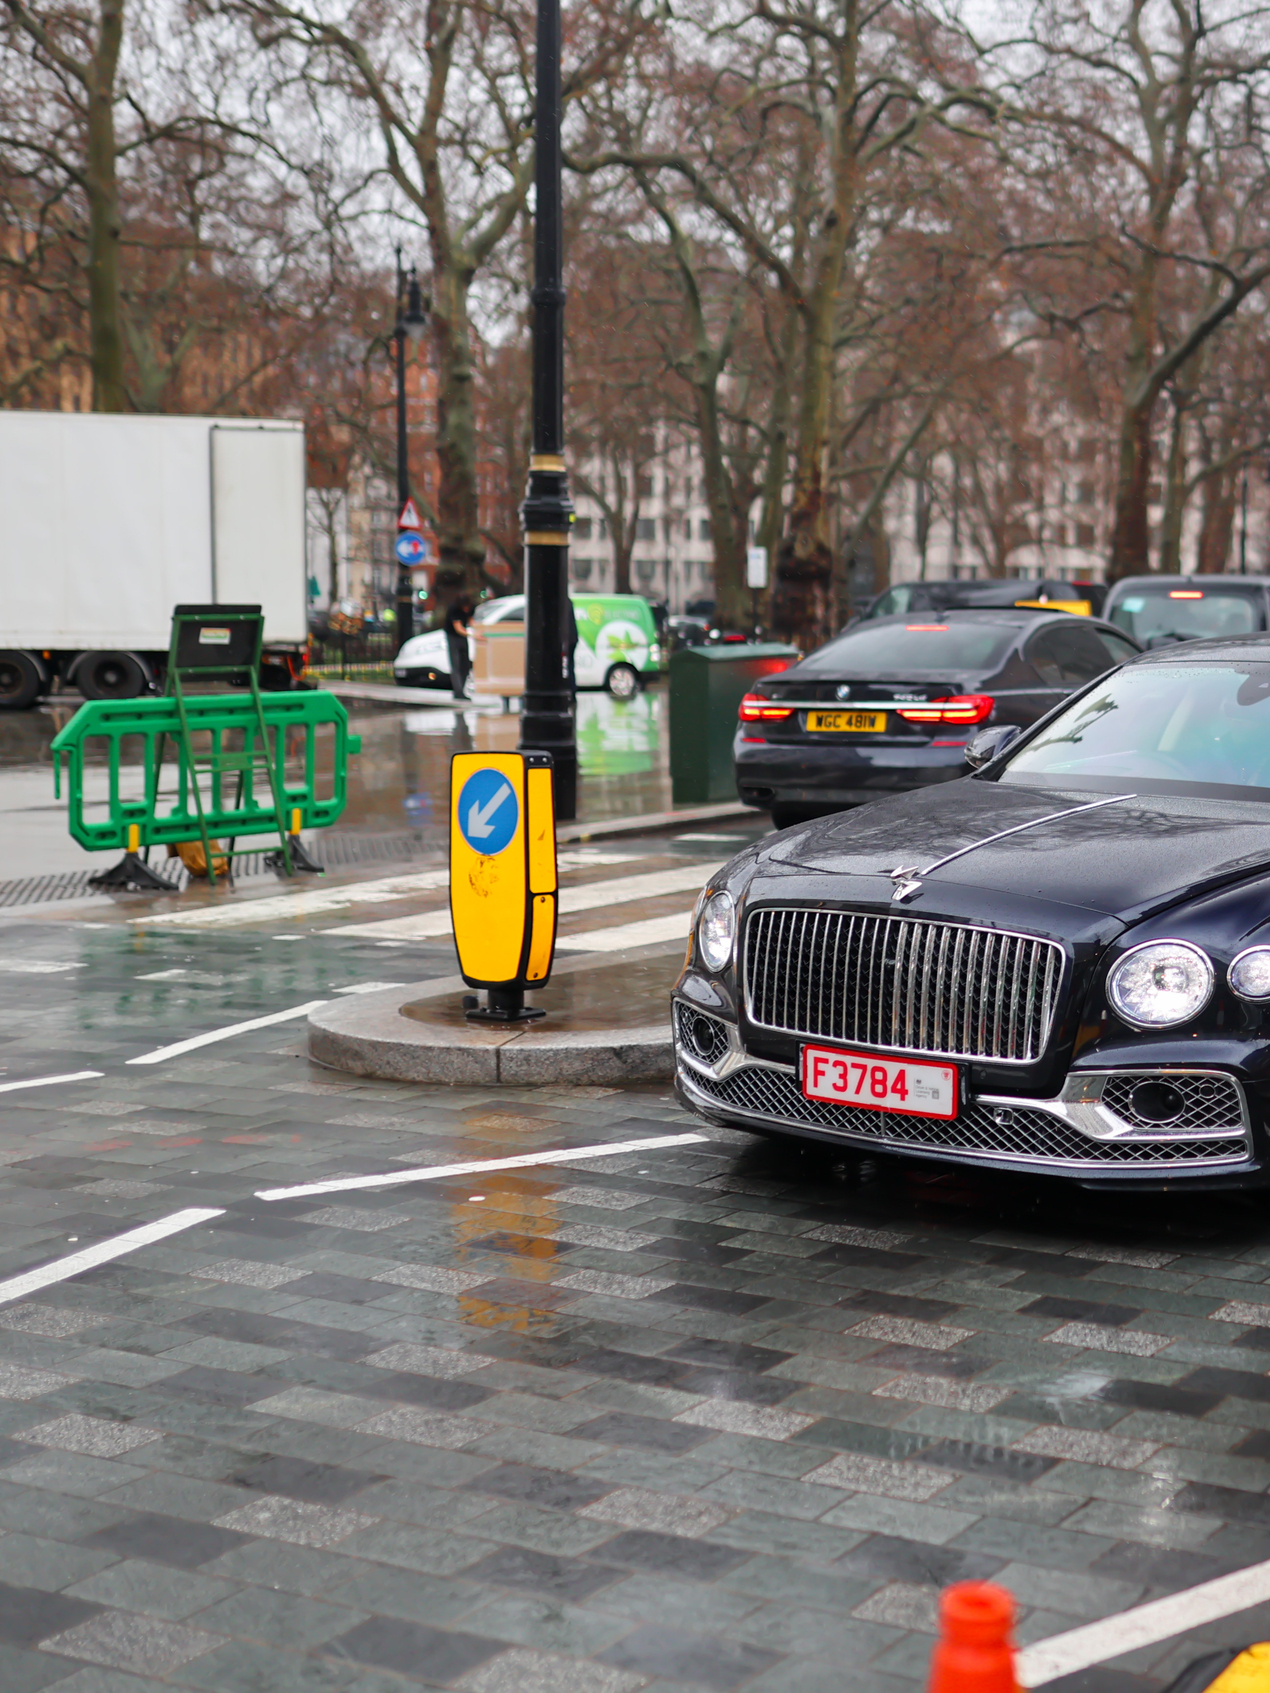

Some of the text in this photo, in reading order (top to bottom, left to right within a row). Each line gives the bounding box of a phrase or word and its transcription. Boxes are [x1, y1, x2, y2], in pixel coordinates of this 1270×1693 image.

[816, 714, 877, 729] WGC 481W
[813, 1056, 909, 1102] F3784
